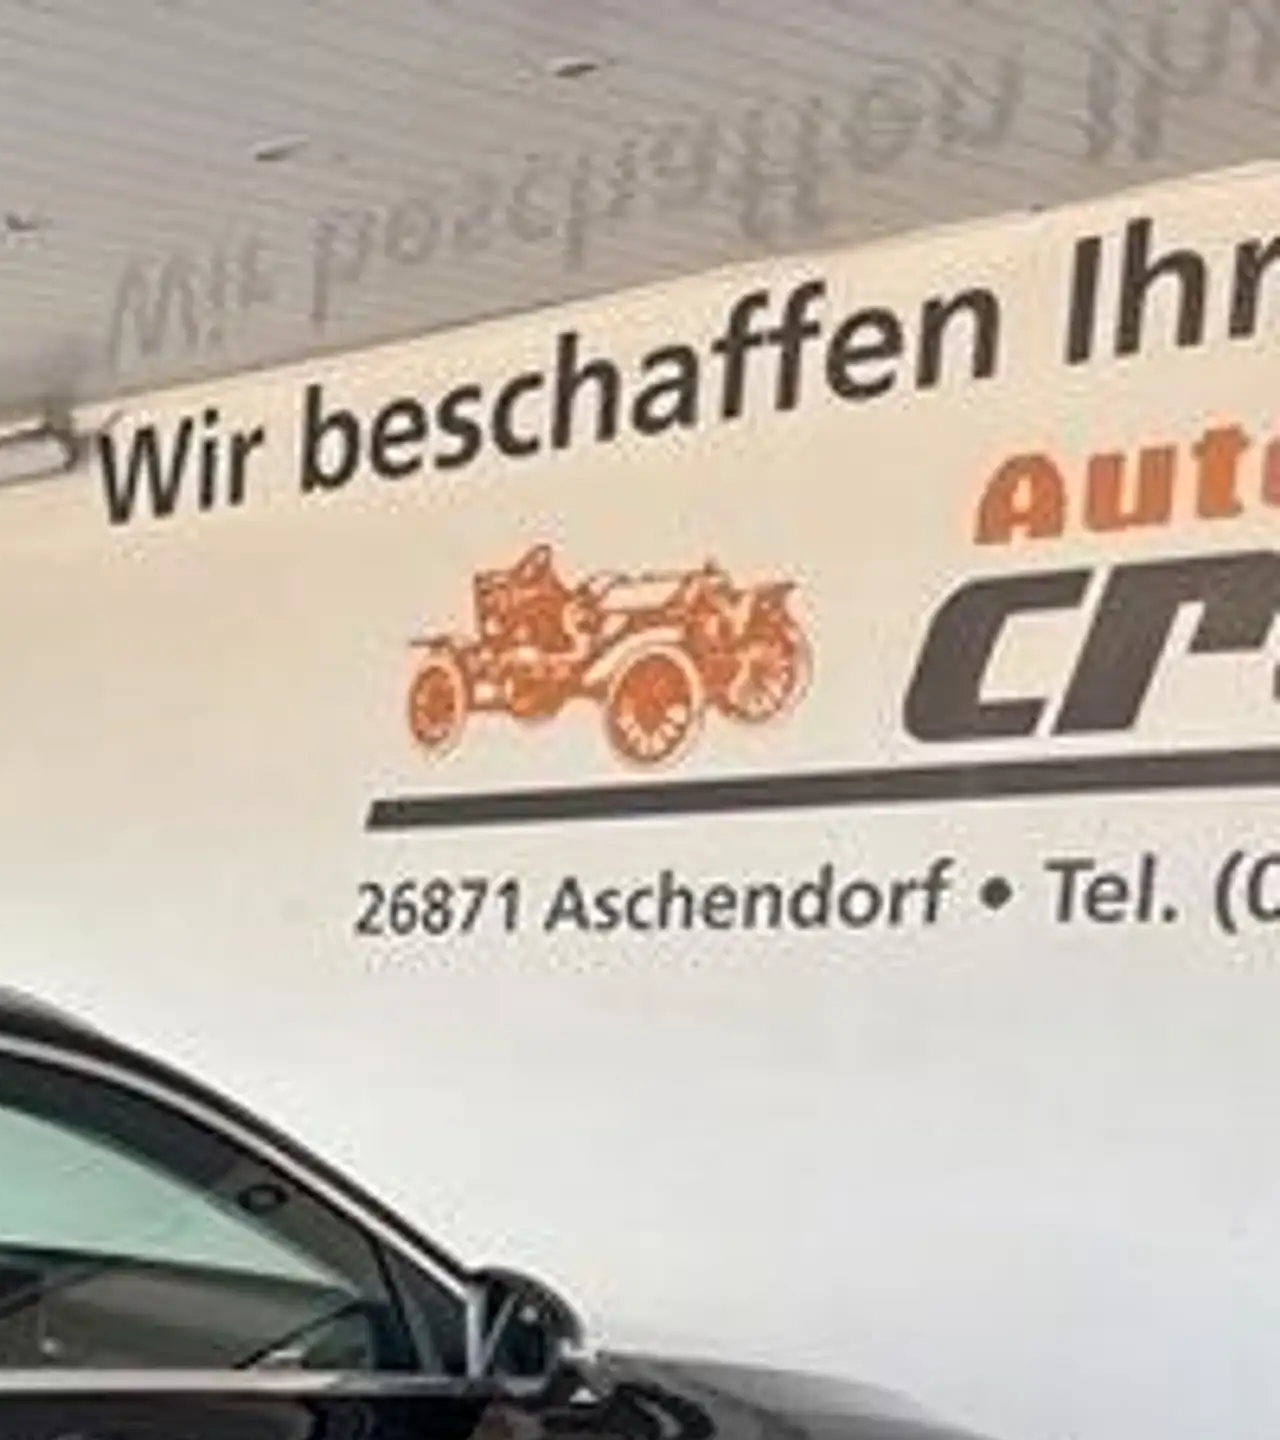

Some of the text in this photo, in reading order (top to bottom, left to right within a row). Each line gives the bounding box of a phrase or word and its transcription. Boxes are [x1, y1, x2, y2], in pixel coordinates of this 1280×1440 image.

[100, 217, 1280, 524] Wir beschaffen Ihr
[974, 424, 1280, 545] Aut
[355, 879, 519, 936] 26871
[543, 858, 952, 931] Aschendorf
[1044, 852, 1176, 923] Tel.
